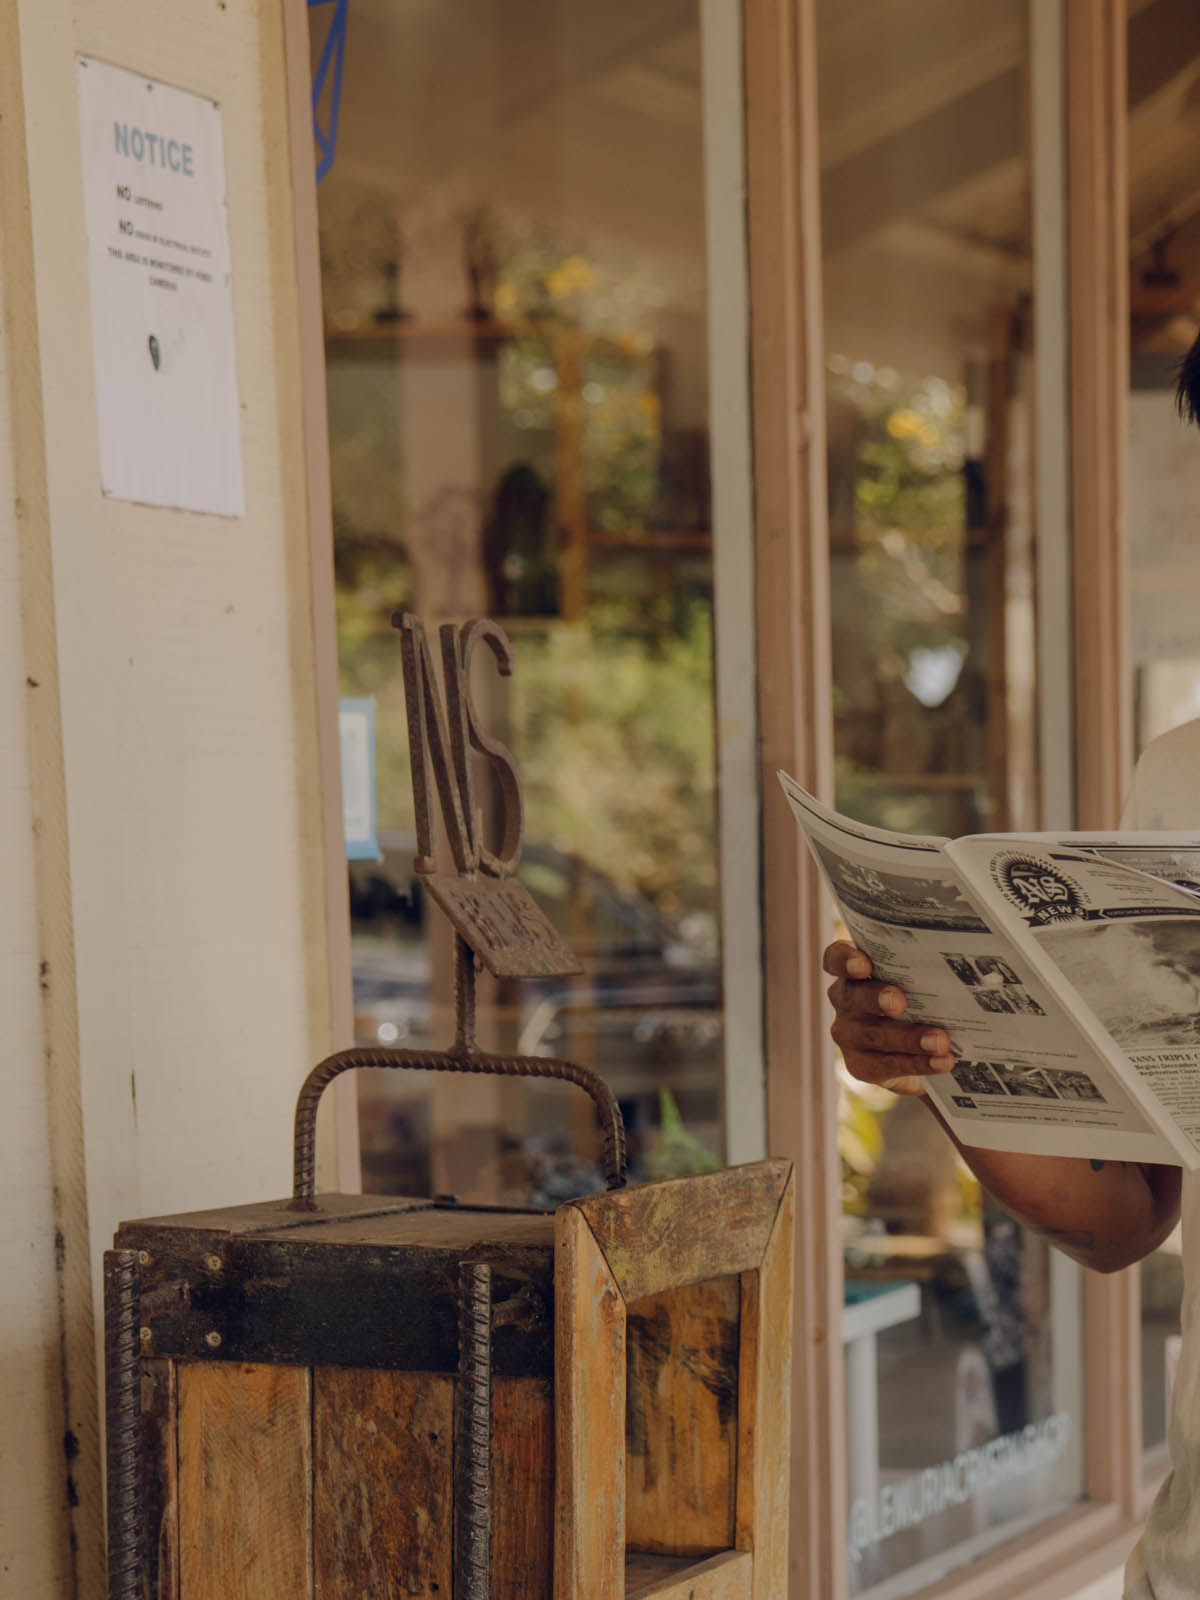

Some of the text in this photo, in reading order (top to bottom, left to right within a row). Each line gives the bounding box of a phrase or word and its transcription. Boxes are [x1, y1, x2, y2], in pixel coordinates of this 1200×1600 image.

[113, 121, 195, 178] NOTICE
[117, 184, 131, 201] NO
[119, 220, 134, 236] NO
[391, 611, 525, 880] NS
[1012, 876, 1069, 904] NS
[1035, 904, 1085, 921] NEWS
[1128, 1055, 1156, 1063] VANS
[1157, 1054, 1191, 1062] TRIPLE
